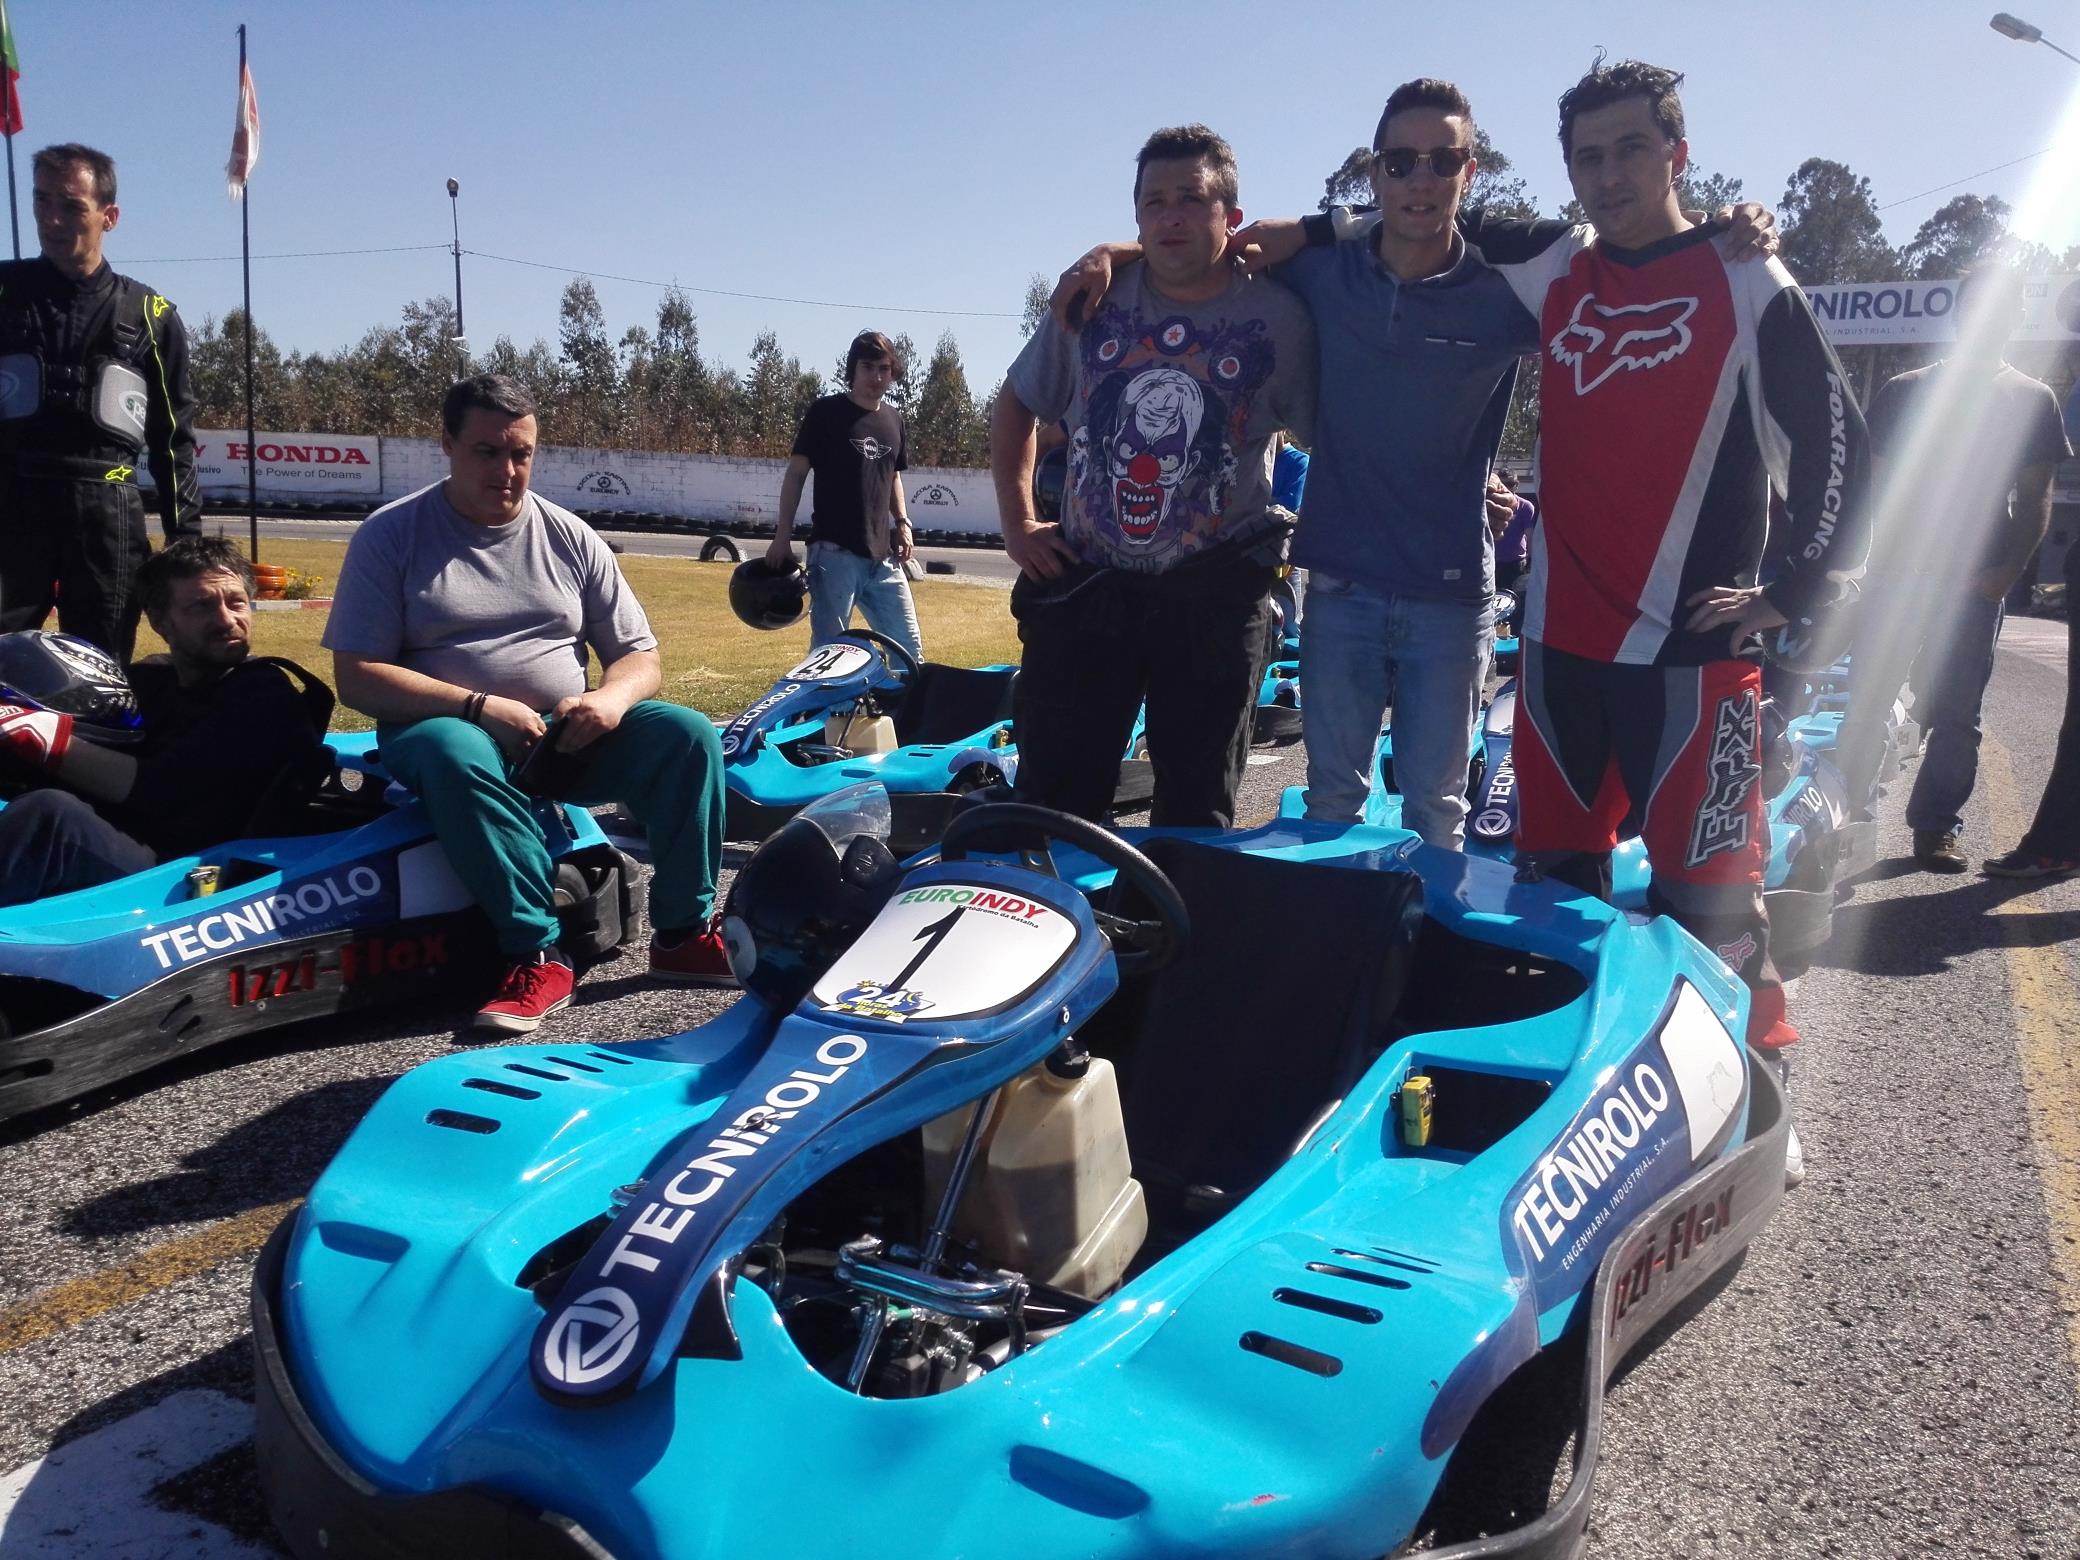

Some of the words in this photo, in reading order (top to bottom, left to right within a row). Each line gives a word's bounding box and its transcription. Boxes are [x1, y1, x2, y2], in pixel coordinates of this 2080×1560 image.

[1805, 287, 1953, 321] NIROLO
[226, 442, 371, 465] HONDA
[240, 466, 262, 476] Te
[266, 467, 302, 478] Power
[305, 468, 315, 478] of
[318, 469, 362, 480] Dreams
[796, 649, 847, 675] 24
[728, 683, 801, 734] TECNIROLO
[141, 866, 381, 969] TECNIROLO
[898, 888, 1048, 919] EUROINDY
[1010, 914, 1039, 929] Batalha
[886, 903, 968, 994] 1
[847, 986, 910, 1008] 24
[600, 1034, 868, 1278] TECNIROLO
[1514, 1063, 1668, 1262] TECNIROLO
[1562, 1207, 1611, 1271] ENGENHARIA
